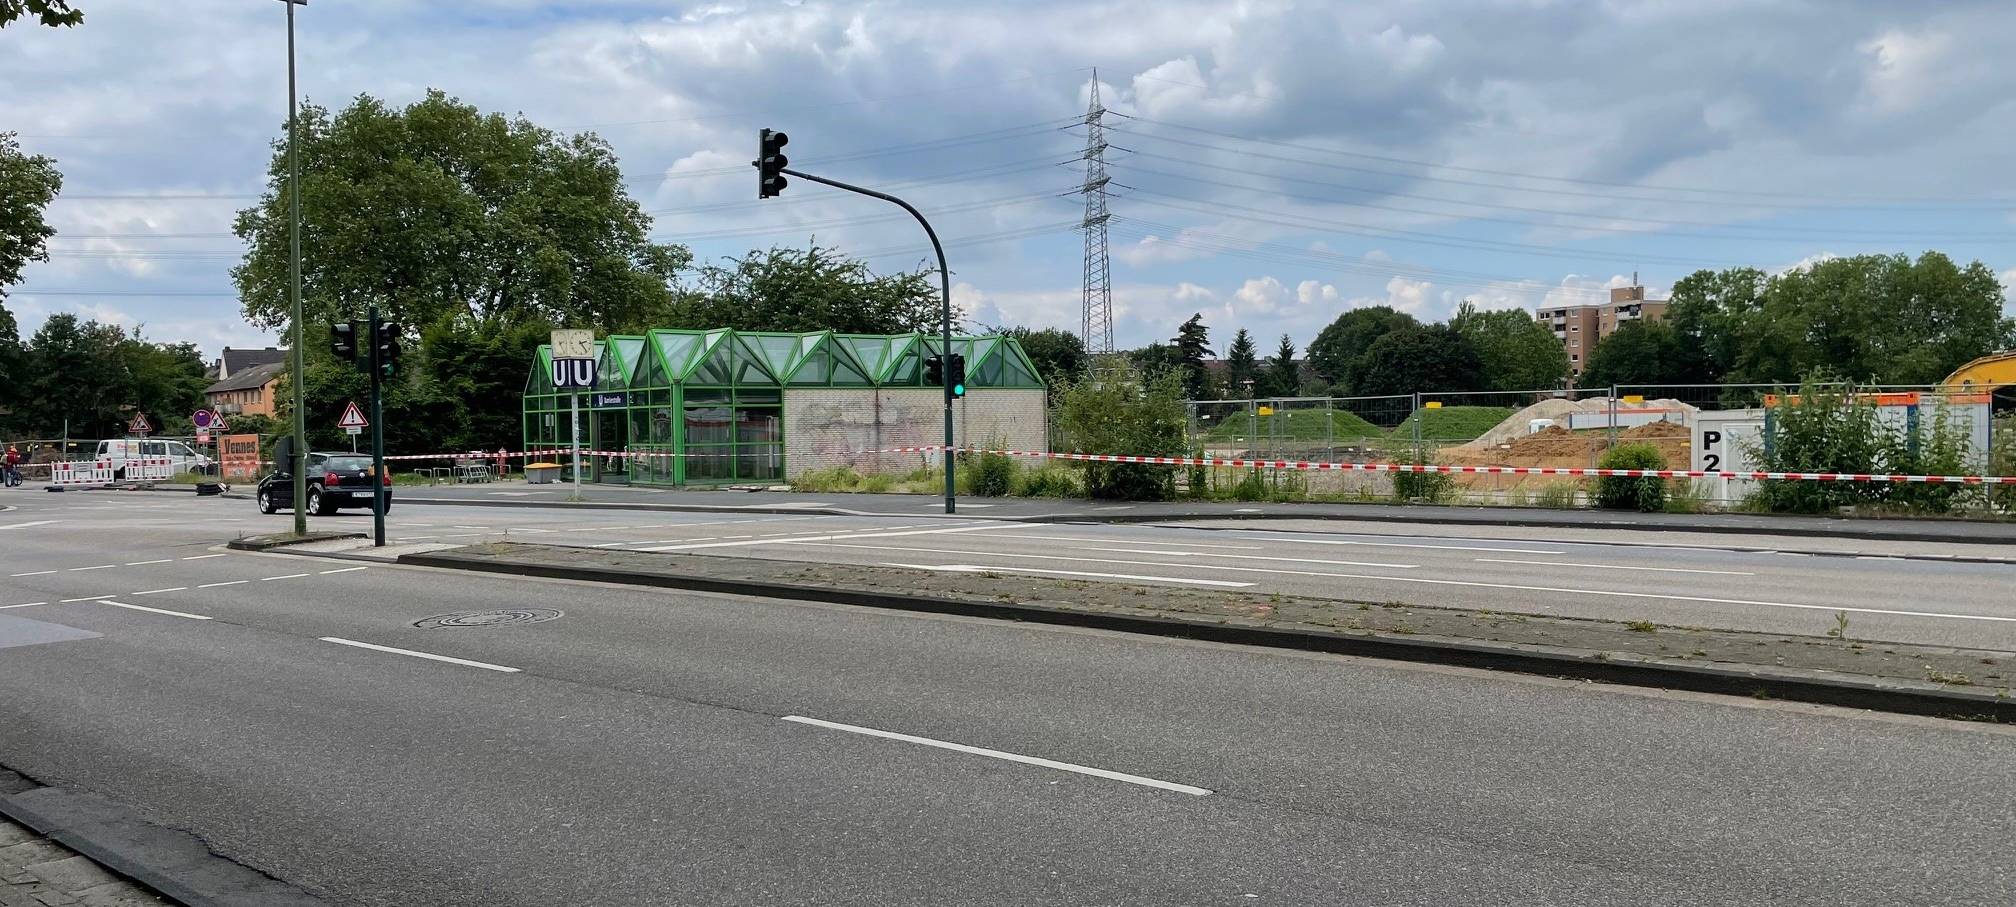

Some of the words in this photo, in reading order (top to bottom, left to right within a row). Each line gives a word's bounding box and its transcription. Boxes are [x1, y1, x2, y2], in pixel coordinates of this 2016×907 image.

[553, 360, 566, 386] U
[574, 360, 593, 386] U
[224, 438, 256, 455] Vennes
[1704, 431, 1721, 450] P
[1704, 454, 1721, 473] 2
